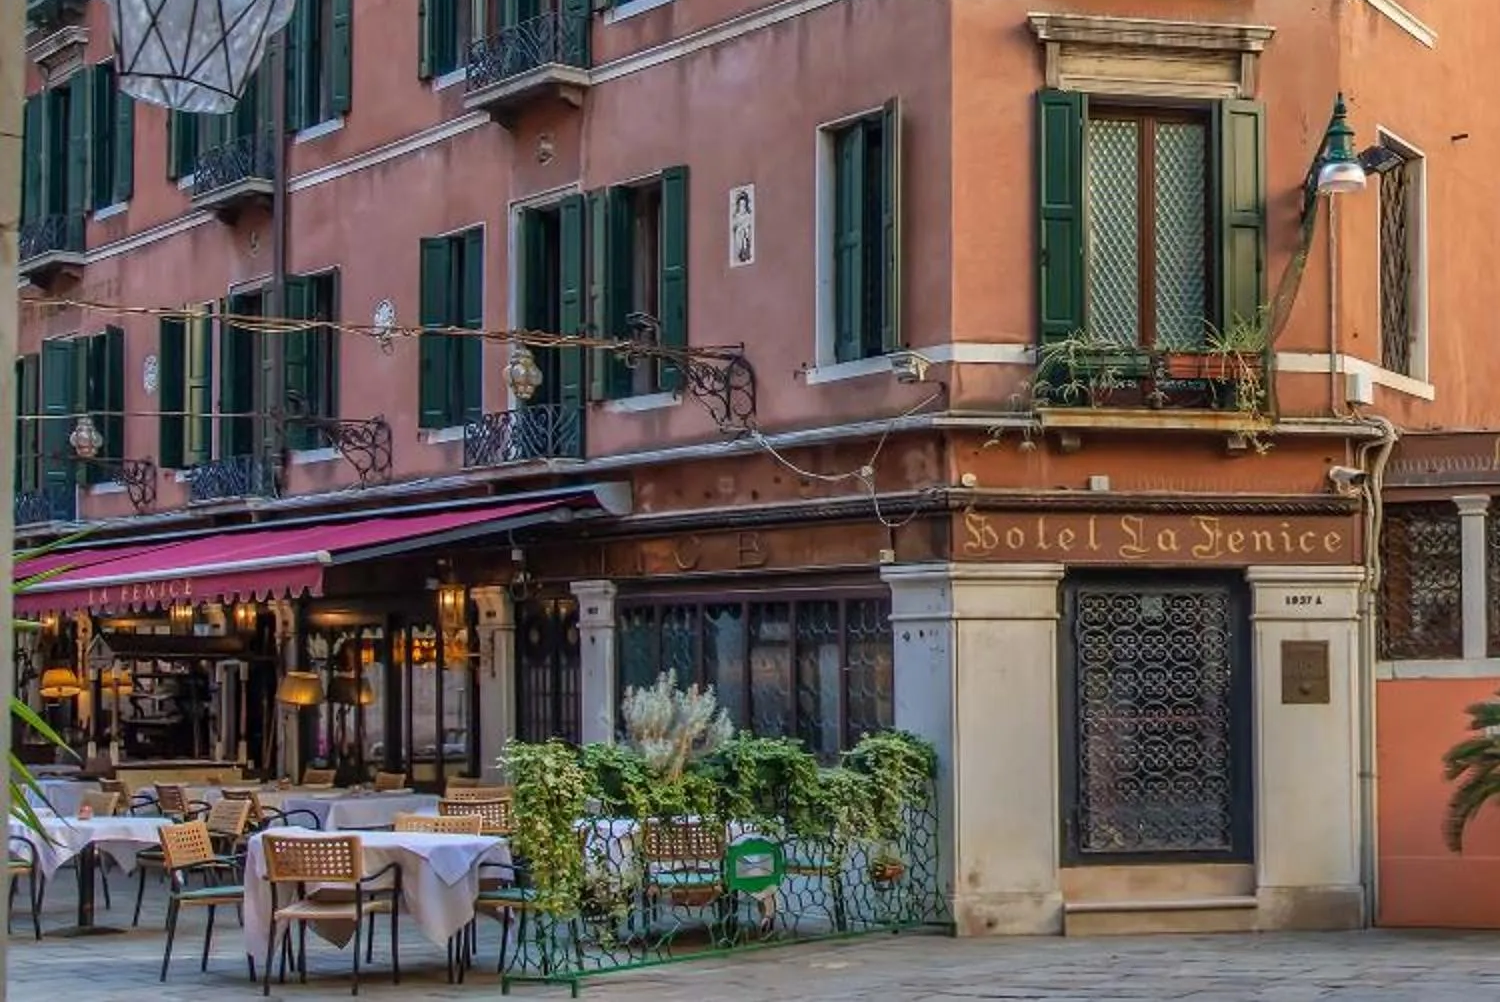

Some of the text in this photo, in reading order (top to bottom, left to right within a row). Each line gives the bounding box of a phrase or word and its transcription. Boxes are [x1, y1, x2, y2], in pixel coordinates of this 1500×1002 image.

[964, 513, 1343, 558] Hotel La Fenice
